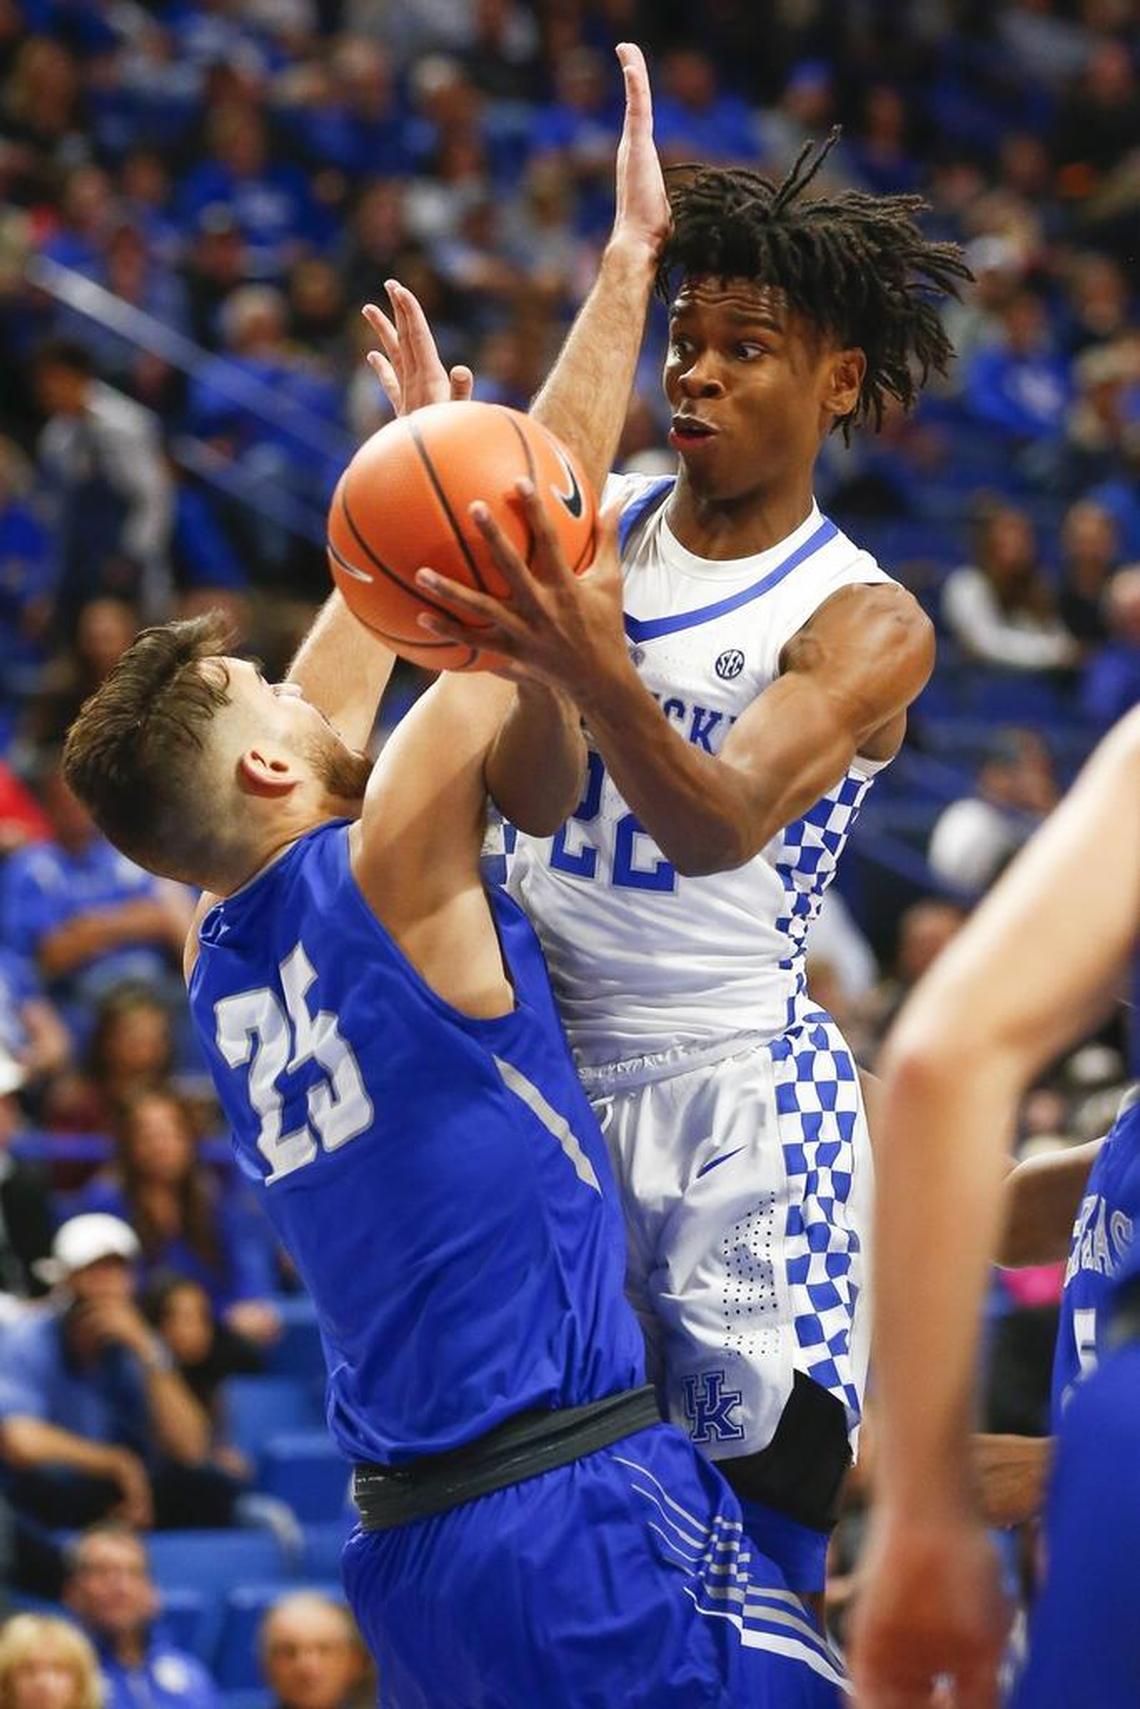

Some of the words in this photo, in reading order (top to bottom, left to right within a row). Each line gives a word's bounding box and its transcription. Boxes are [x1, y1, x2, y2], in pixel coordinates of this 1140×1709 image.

[715, 650, 745, 680] SEC
[213, 940, 374, 1187] 25
[680, 1370, 744, 1443] UK
